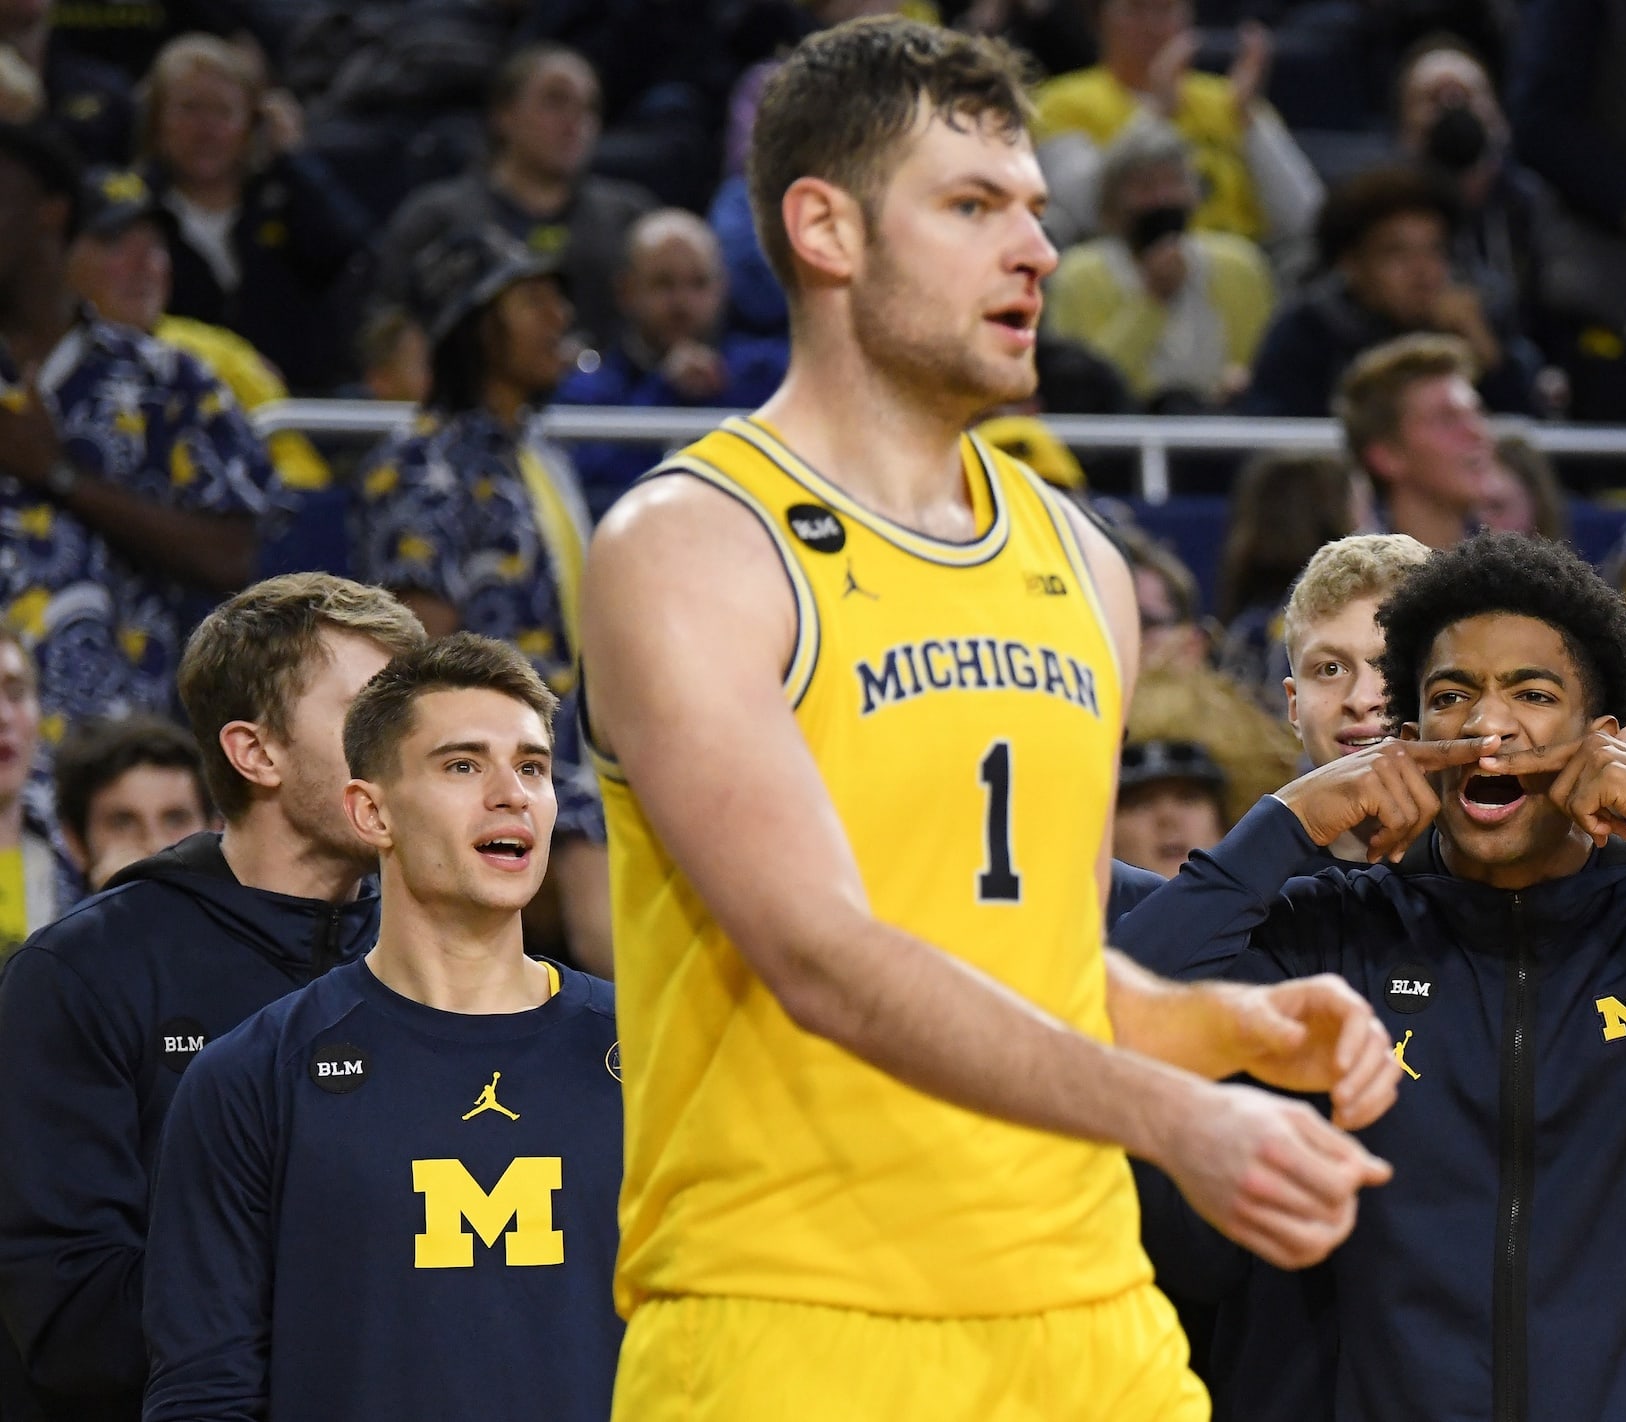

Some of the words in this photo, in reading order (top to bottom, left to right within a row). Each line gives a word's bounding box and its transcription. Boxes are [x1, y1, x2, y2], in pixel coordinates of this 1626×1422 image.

[857, 638, 1099, 716] MICHIGAN
[980, 742, 1020, 902] 1
[1390, 979, 1432, 997] BLM
[163, 1034, 204, 1053] BLM
[316, 1060, 365, 1078] BLM
[412, 1156, 564, 1269] M
